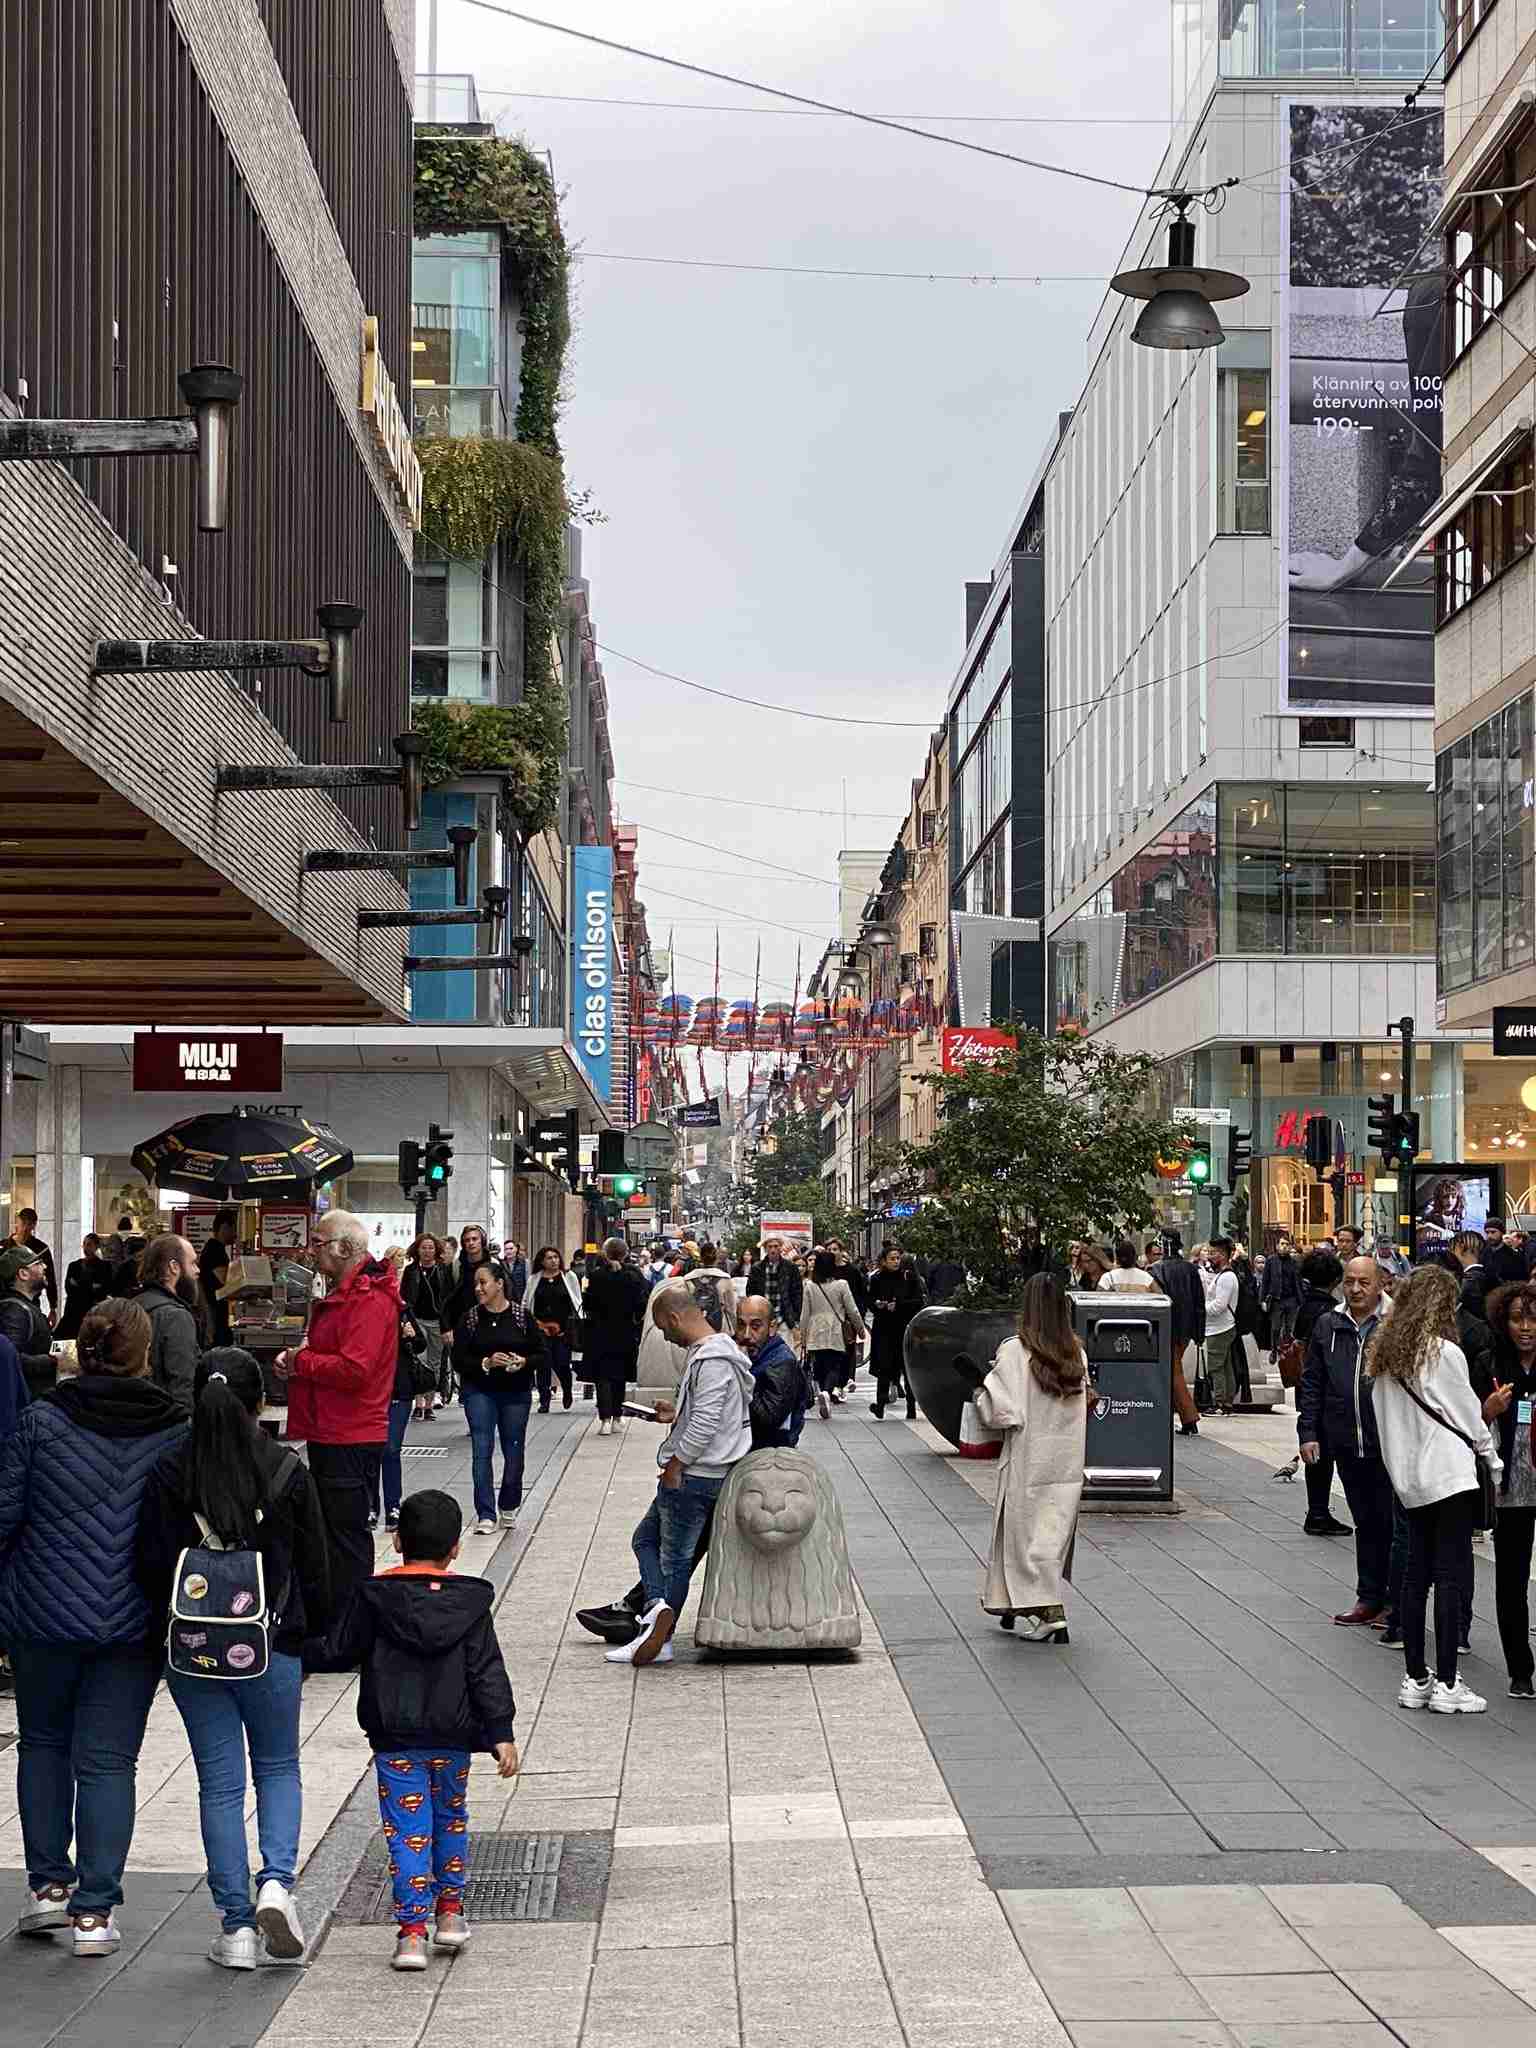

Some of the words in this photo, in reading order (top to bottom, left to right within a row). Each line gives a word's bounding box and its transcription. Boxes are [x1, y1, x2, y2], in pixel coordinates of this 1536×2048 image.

[1312, 375, 1385, 394] Klänning
[1390, 380, 1410, 391] av
[1312, 392, 1409, 409] återvunnen
[579, 890, 608, 989] ohlson
[579, 994, 608, 1057] clas
[179, 1042, 237, 1068] MUJI
[1111, 1400, 1154, 1408] Stockholms
